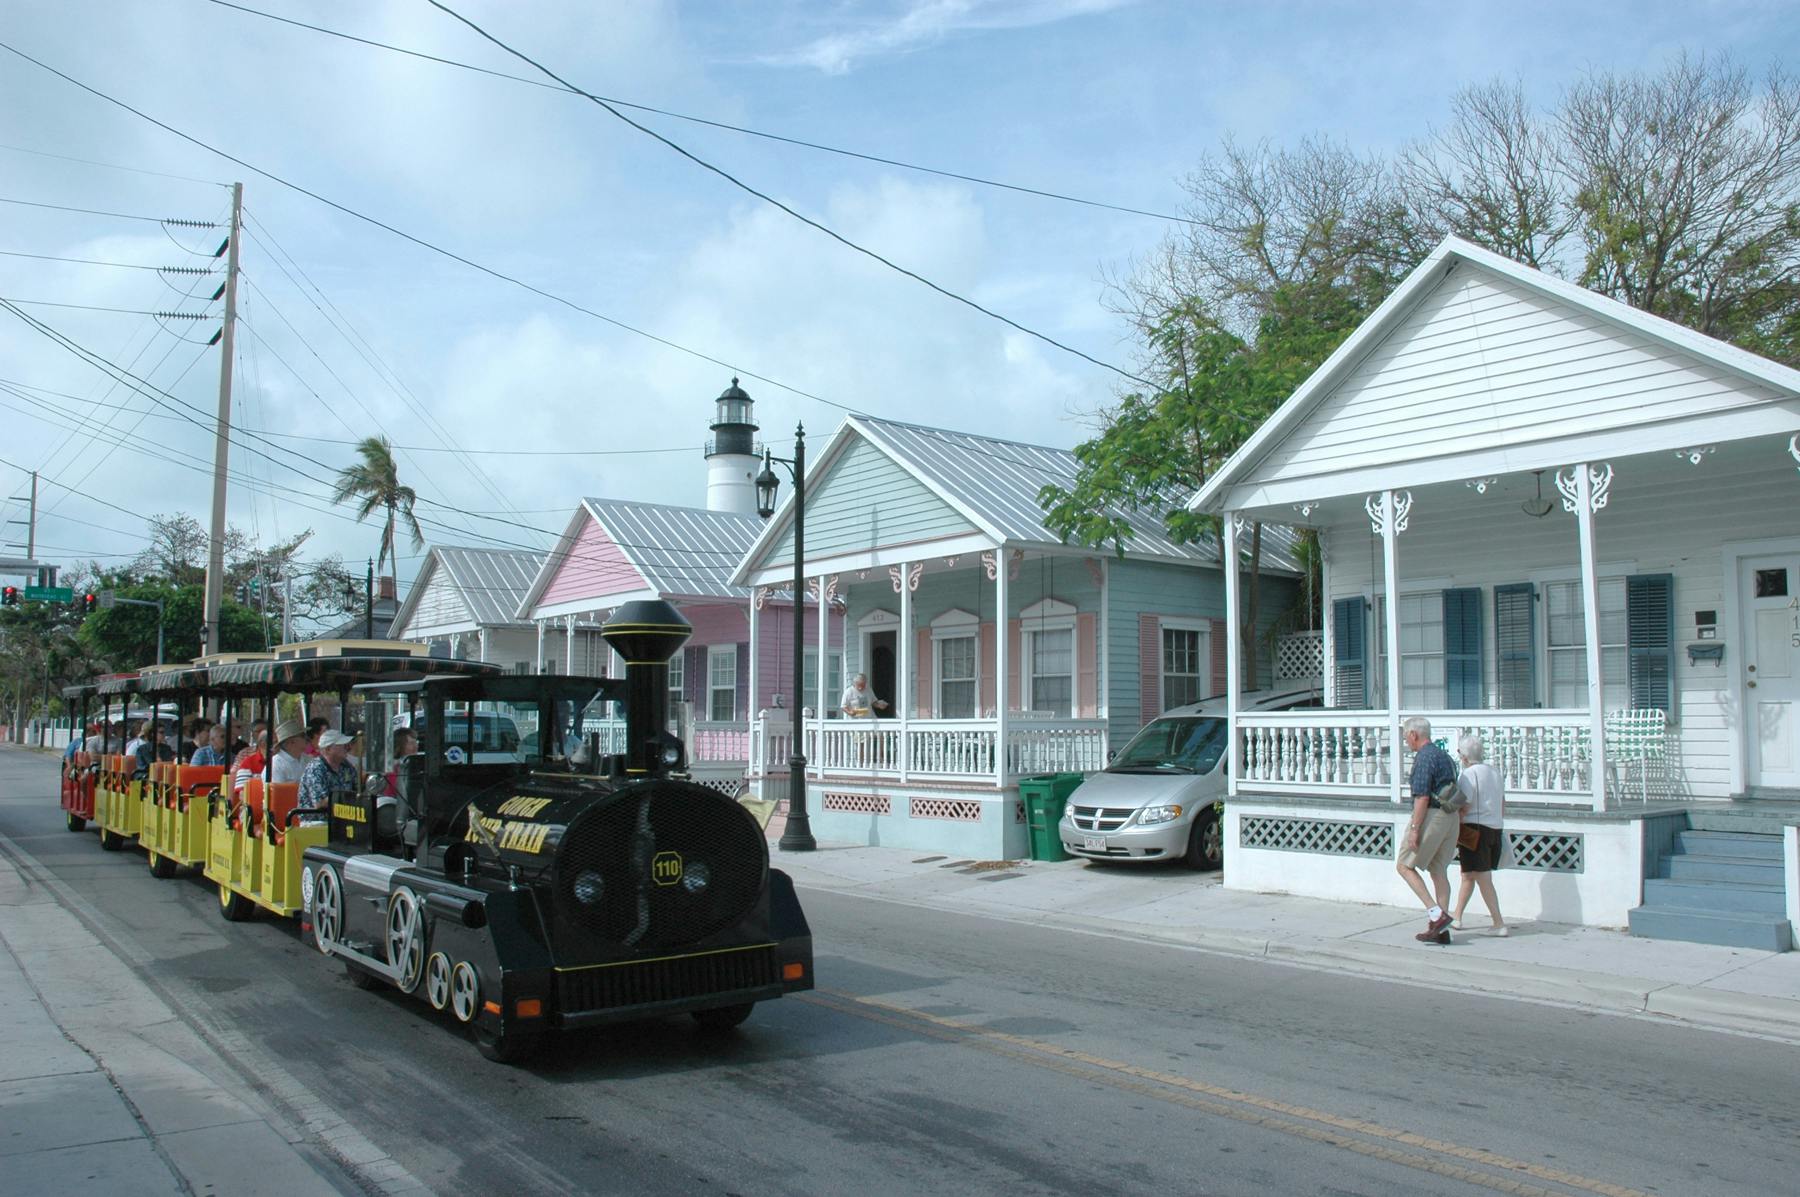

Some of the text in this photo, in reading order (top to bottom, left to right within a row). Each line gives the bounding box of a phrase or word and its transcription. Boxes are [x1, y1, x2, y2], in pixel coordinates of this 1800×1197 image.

[496, 795, 552, 818] CONCH
[499, 821, 551, 854] TRAIN
[656, 860, 679, 877] 110
